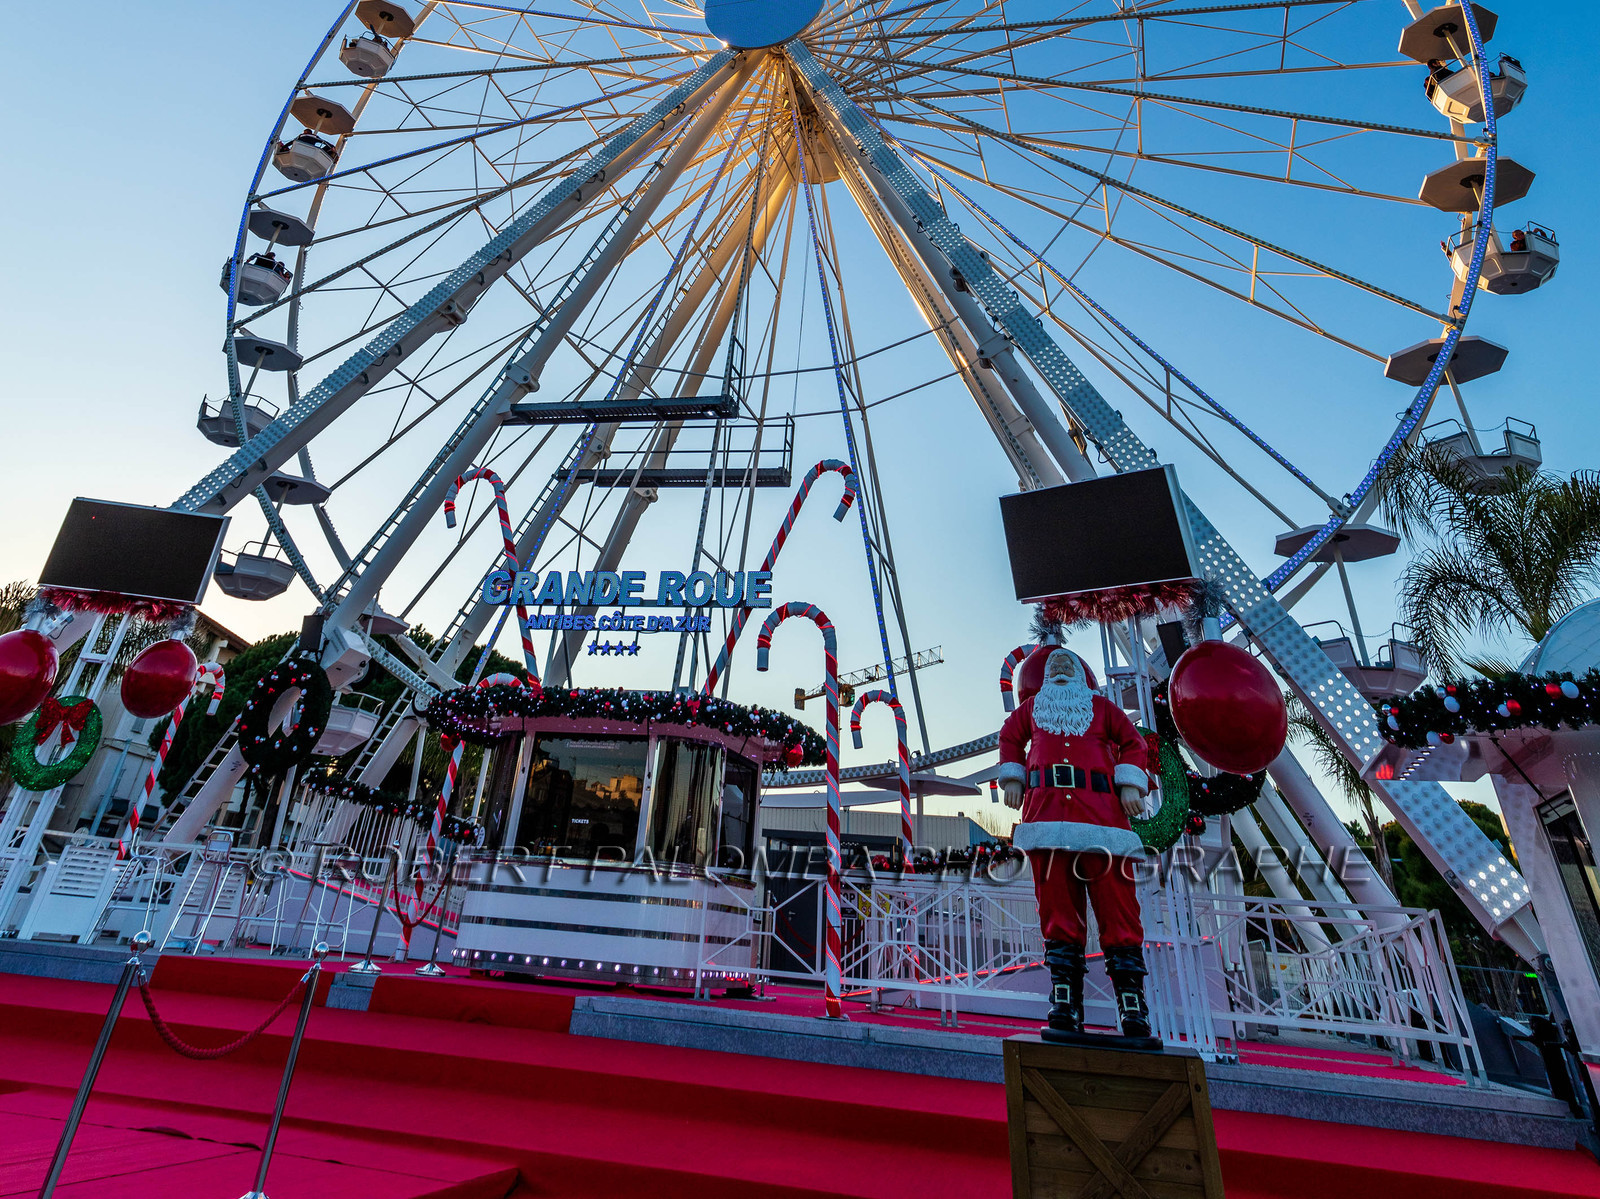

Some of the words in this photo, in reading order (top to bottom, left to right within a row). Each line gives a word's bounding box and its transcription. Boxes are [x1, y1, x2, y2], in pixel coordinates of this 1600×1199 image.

[482, 571, 647, 606] GRANDE
[656, 571, 773, 607] ROUE
[524, 614, 597, 631] ANTIBES
[599, 611, 645, 632] CÔTE
[646, 615, 711, 633] D'AZUR
